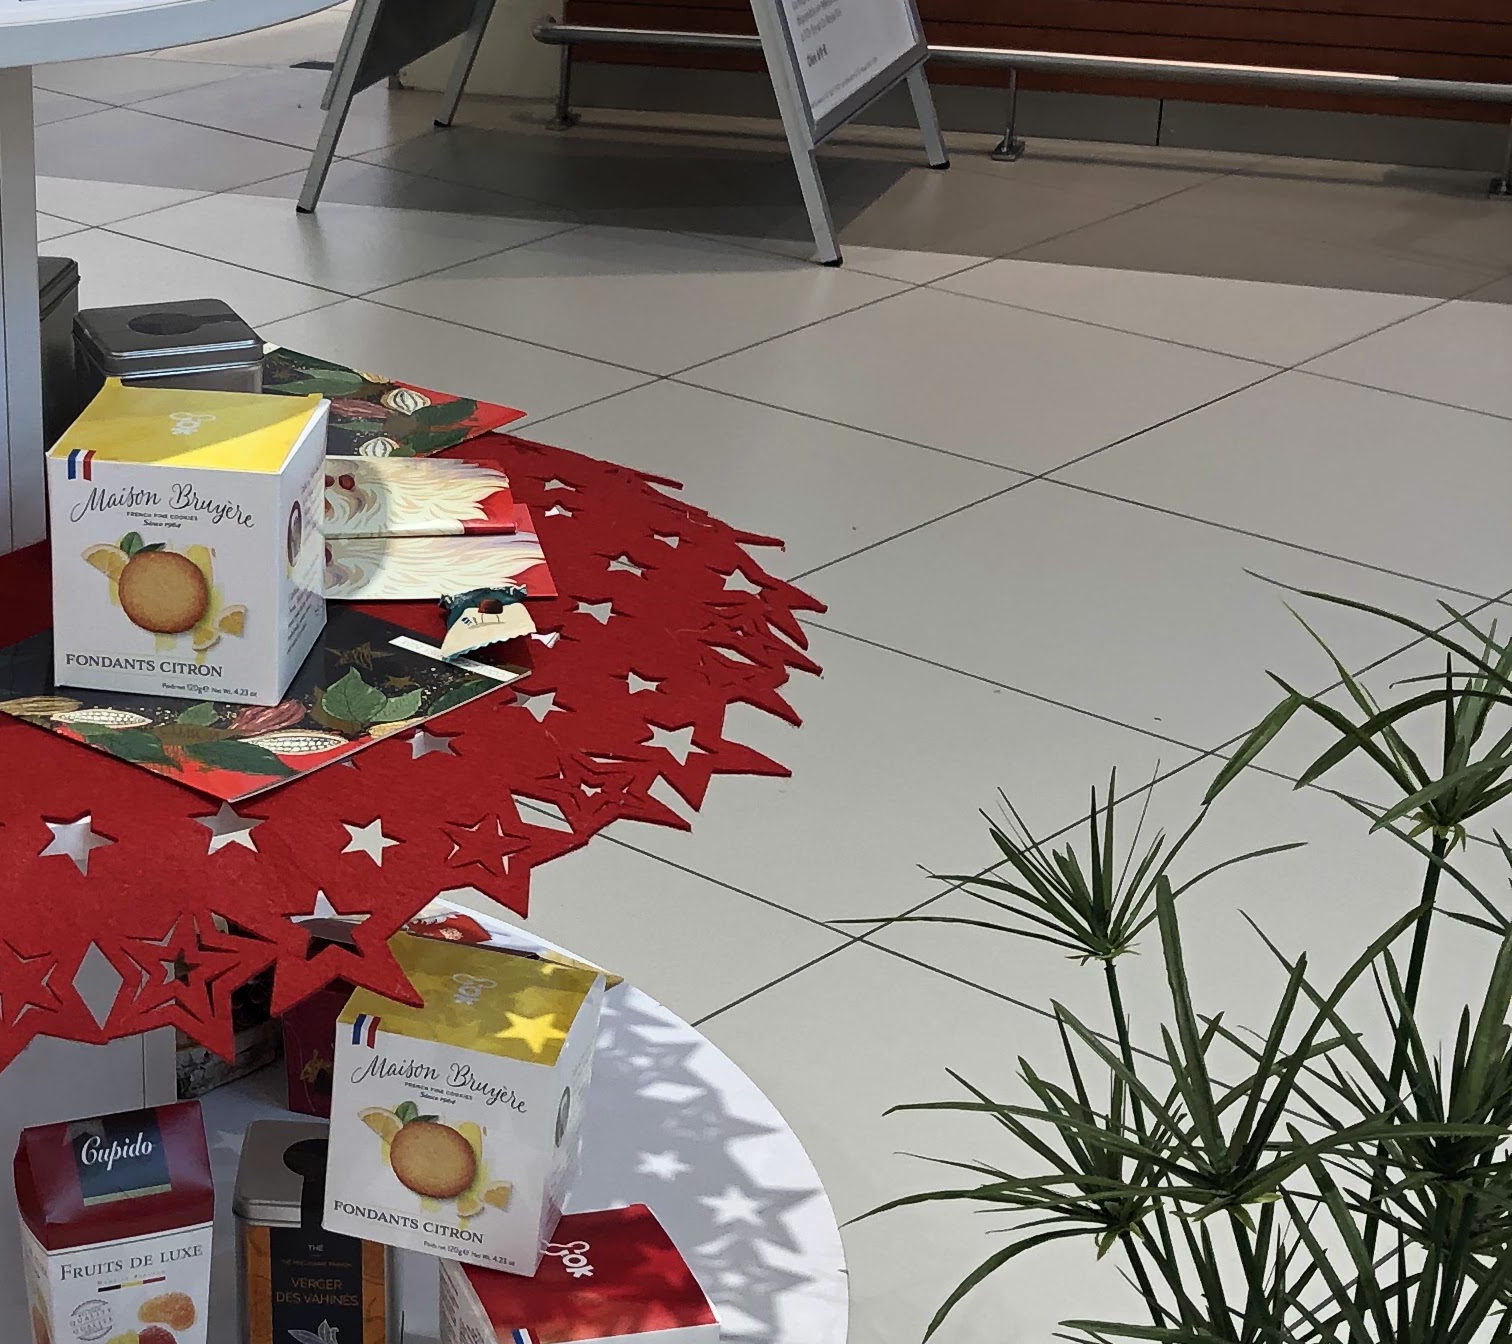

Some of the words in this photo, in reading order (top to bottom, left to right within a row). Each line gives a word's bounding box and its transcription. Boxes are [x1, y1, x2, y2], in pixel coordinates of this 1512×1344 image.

[70, 488, 162, 522] Maison
[168, 483, 255, 529] Bruyère
[65, 653, 156, 672] FONDANTS
[159, 661, 223, 678] CITRON
[351, 1055, 440, 1083] Maison
[446, 1062, 528, 1114] Bruyère
[81, 1131, 154, 1171] Cupido
[334, 1200, 419, 1229] FONDANTS
[423, 1221, 484, 1244] CITRON
[61, 1260, 123, 1280] FRUITS
[130, 1255, 153, 1269] DE
[160, 1245, 203, 1263] LUXE
[308, 1243, 324, 1252] THÉ
[276, 1291, 301, 1303] DES
[304, 1292, 358, 1306] VAHINÉS
[292, 1277, 343, 1290] VERGER
